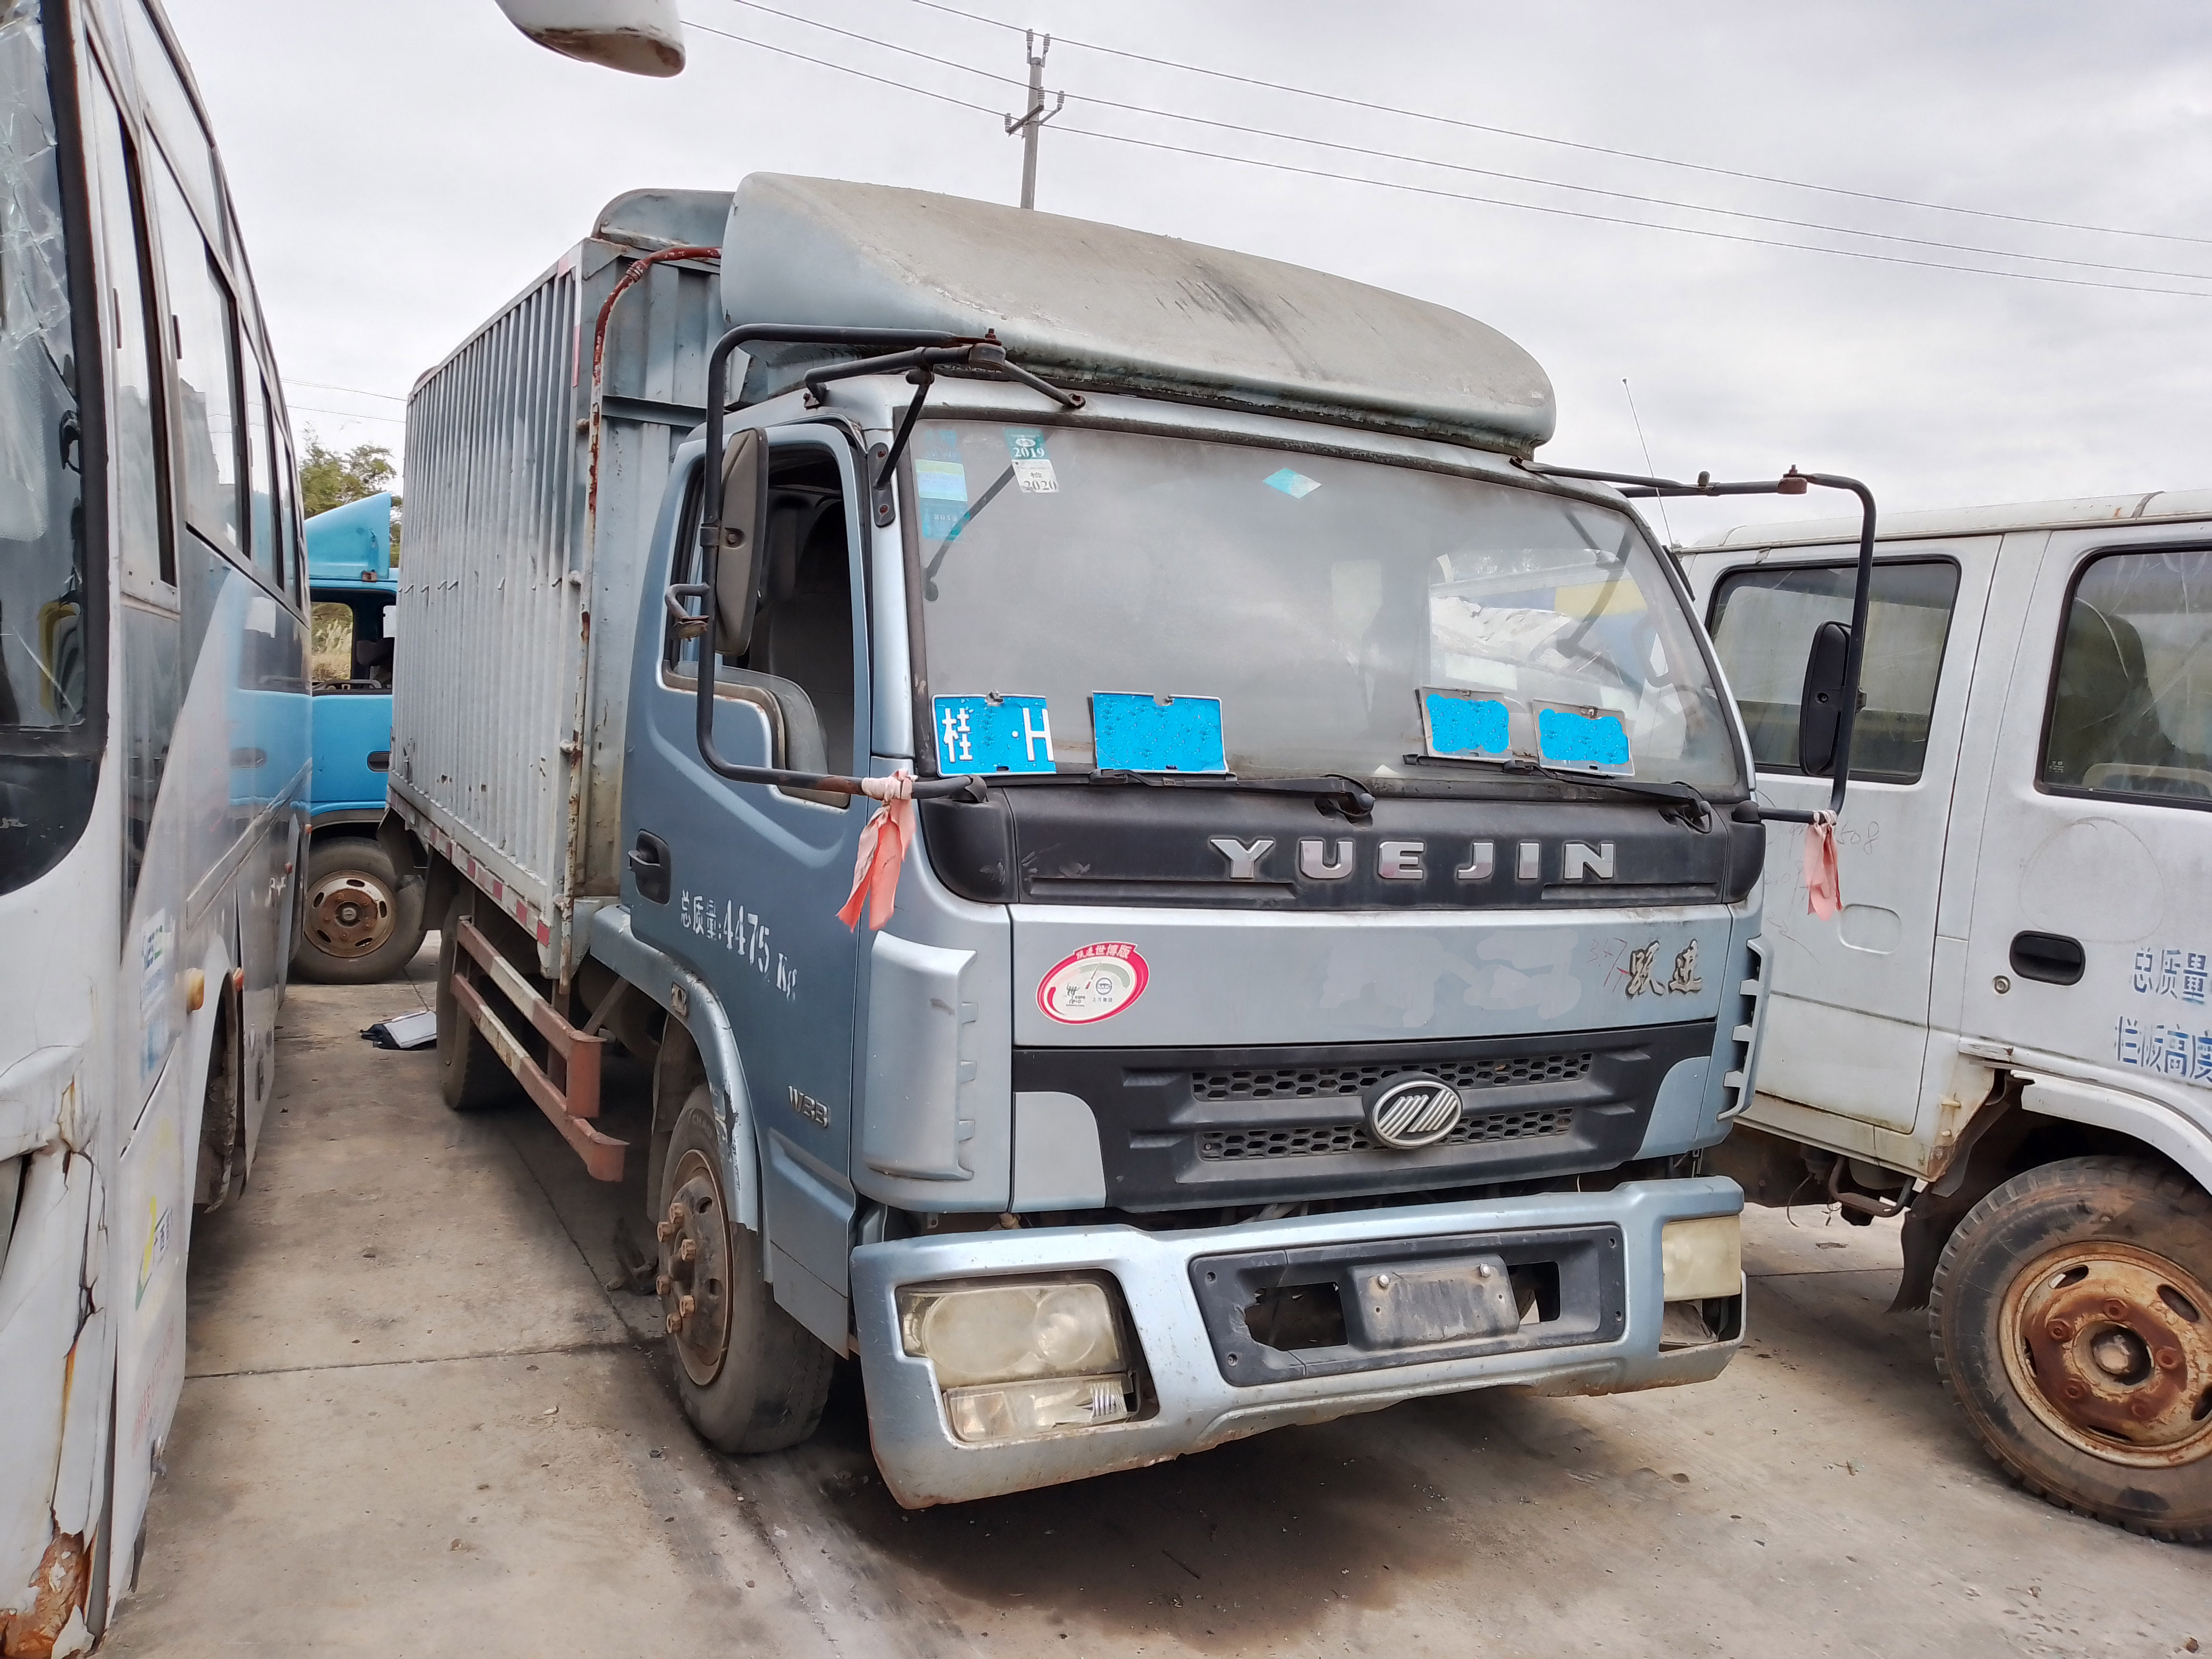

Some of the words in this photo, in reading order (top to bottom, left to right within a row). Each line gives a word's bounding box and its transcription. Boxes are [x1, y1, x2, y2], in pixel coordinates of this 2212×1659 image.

[1013, 447, 1045, 457] 2019
[1024, 480, 1057, 490] 2020
[1210, 839, 1614, 879] YUEJIN
[1076, 943, 1132, 959] 跃进世博版
[1624, 938, 1703, 1000] 跃进
